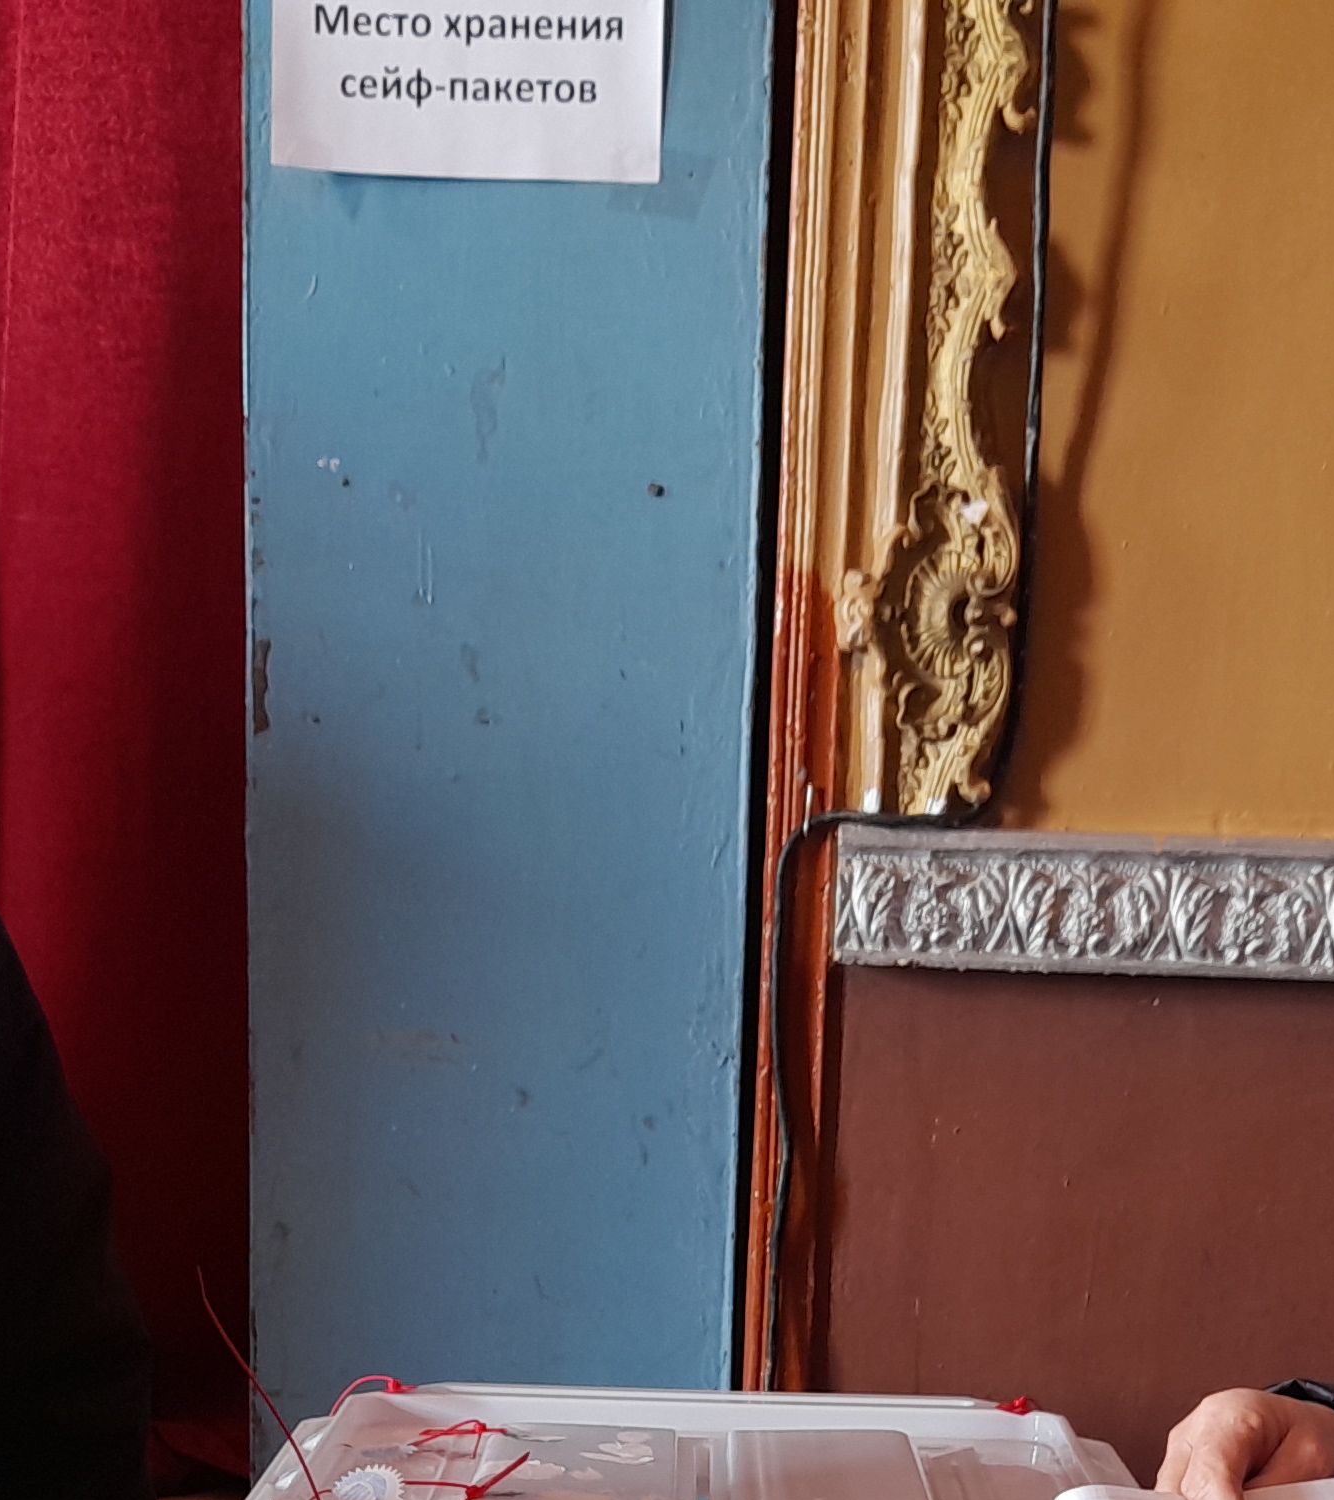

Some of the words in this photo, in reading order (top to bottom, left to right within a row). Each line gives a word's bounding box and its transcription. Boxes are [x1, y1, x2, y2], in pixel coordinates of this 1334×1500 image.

[315, 4, 431, 38] Место
[444, 14, 624, 46] хранения
[340, 65, 597, 108] сейф-пакетов
